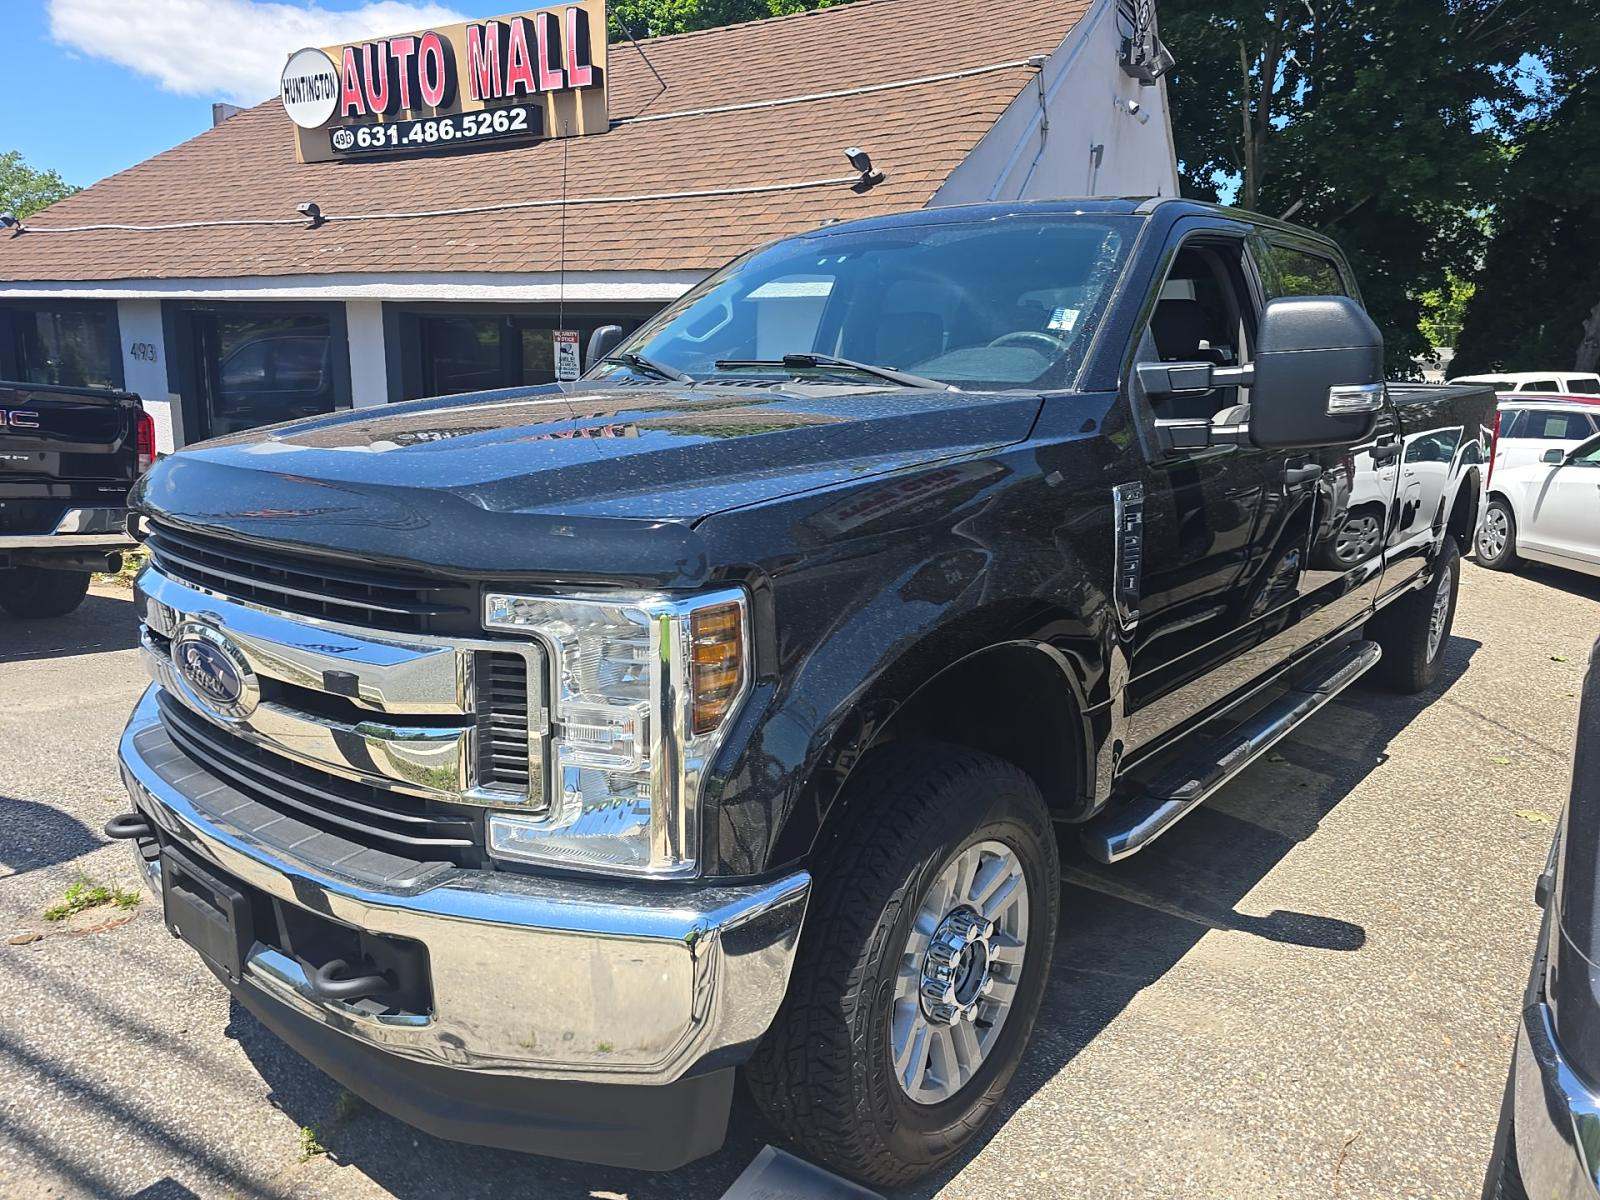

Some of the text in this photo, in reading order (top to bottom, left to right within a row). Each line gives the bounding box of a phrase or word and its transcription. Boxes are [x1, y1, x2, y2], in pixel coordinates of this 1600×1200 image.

[341, 7, 592, 116] AUTO MALL
[283, 72, 336, 104] HUNTINGTON
[335, 107, 528, 148] 493 631.486.5262
[130, 342, 156, 361] 493
